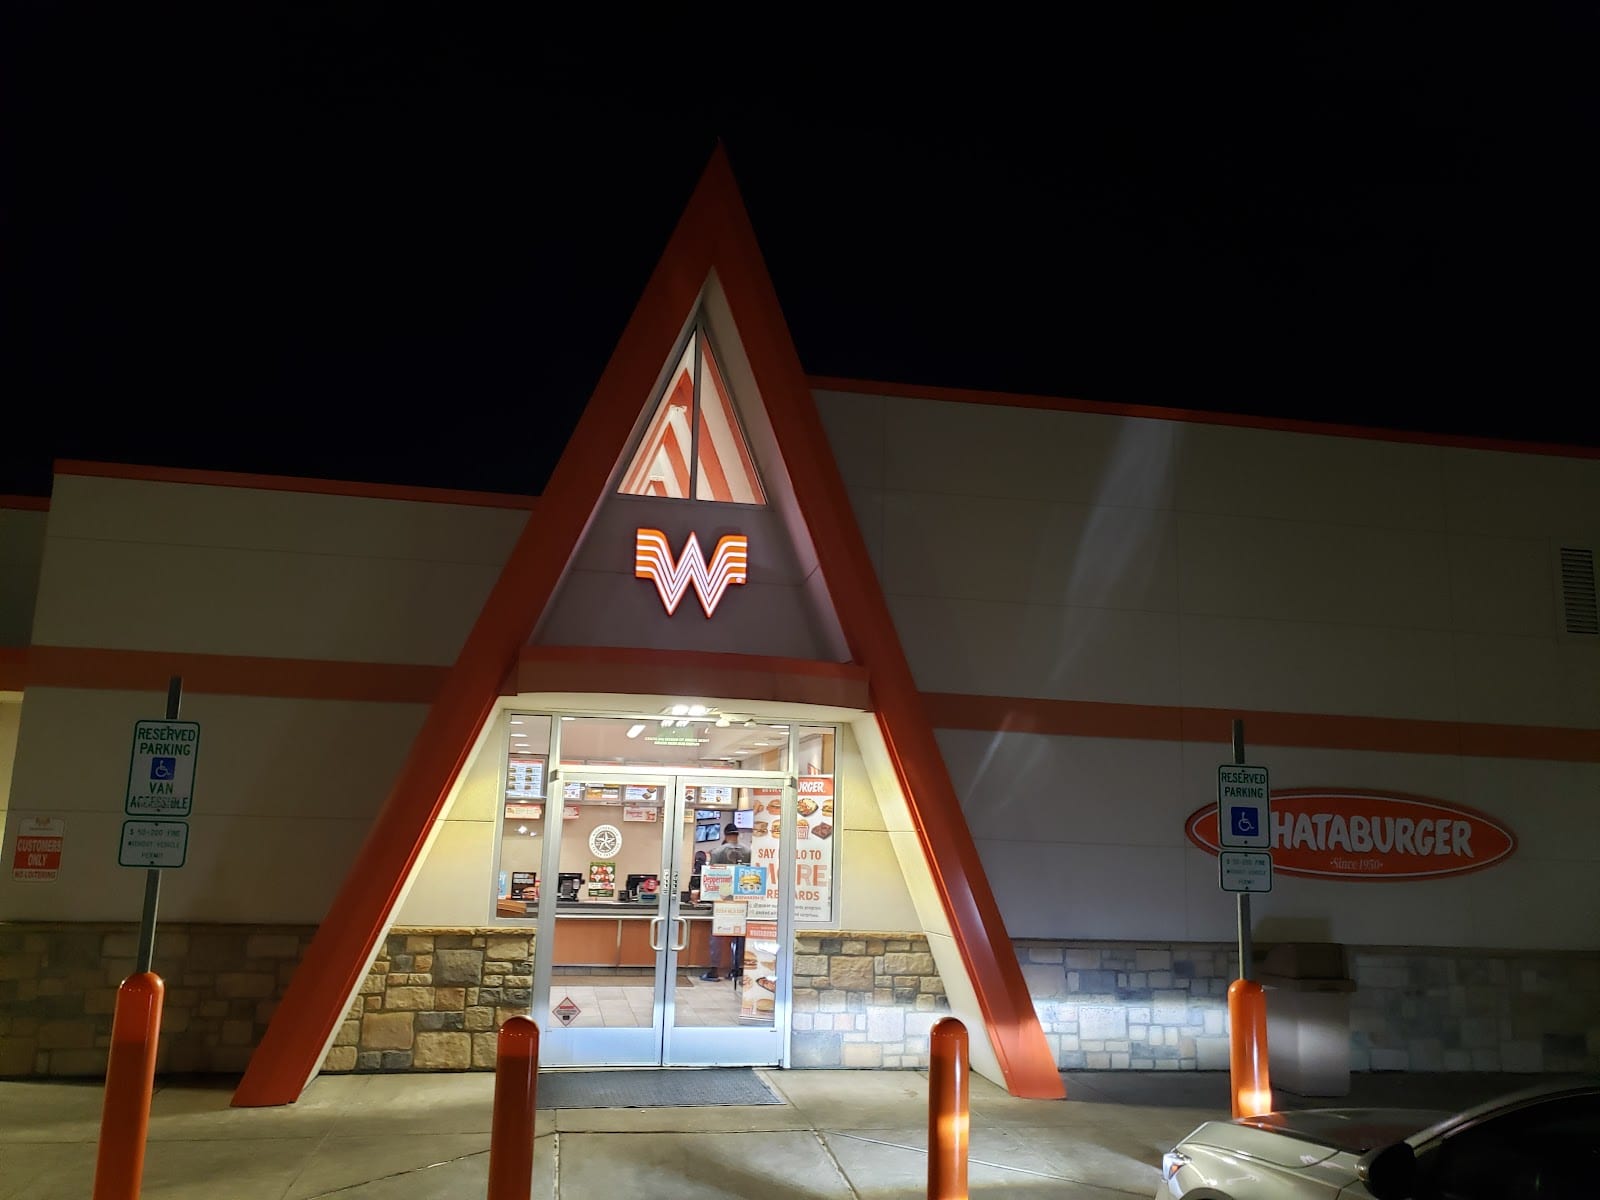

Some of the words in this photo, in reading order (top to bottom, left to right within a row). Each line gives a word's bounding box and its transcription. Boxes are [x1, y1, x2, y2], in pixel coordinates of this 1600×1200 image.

[137, 727, 196, 742] RESERVED
[139, 742, 191, 757] PARKING
[1221, 771, 1266, 785] RESERVED
[149, 782, 174, 795] VAN
[1224, 786, 1264, 799] PARKING
[129, 795, 189, 810] ACCESSIBLE
[1270, 811, 1475, 858] HATABURGER
[17, 838, 61, 853] CUSTOMERS
[27, 853, 48, 866] ONLY
[758, 848, 775, 859] SAY
[810, 850, 822, 860] TO
